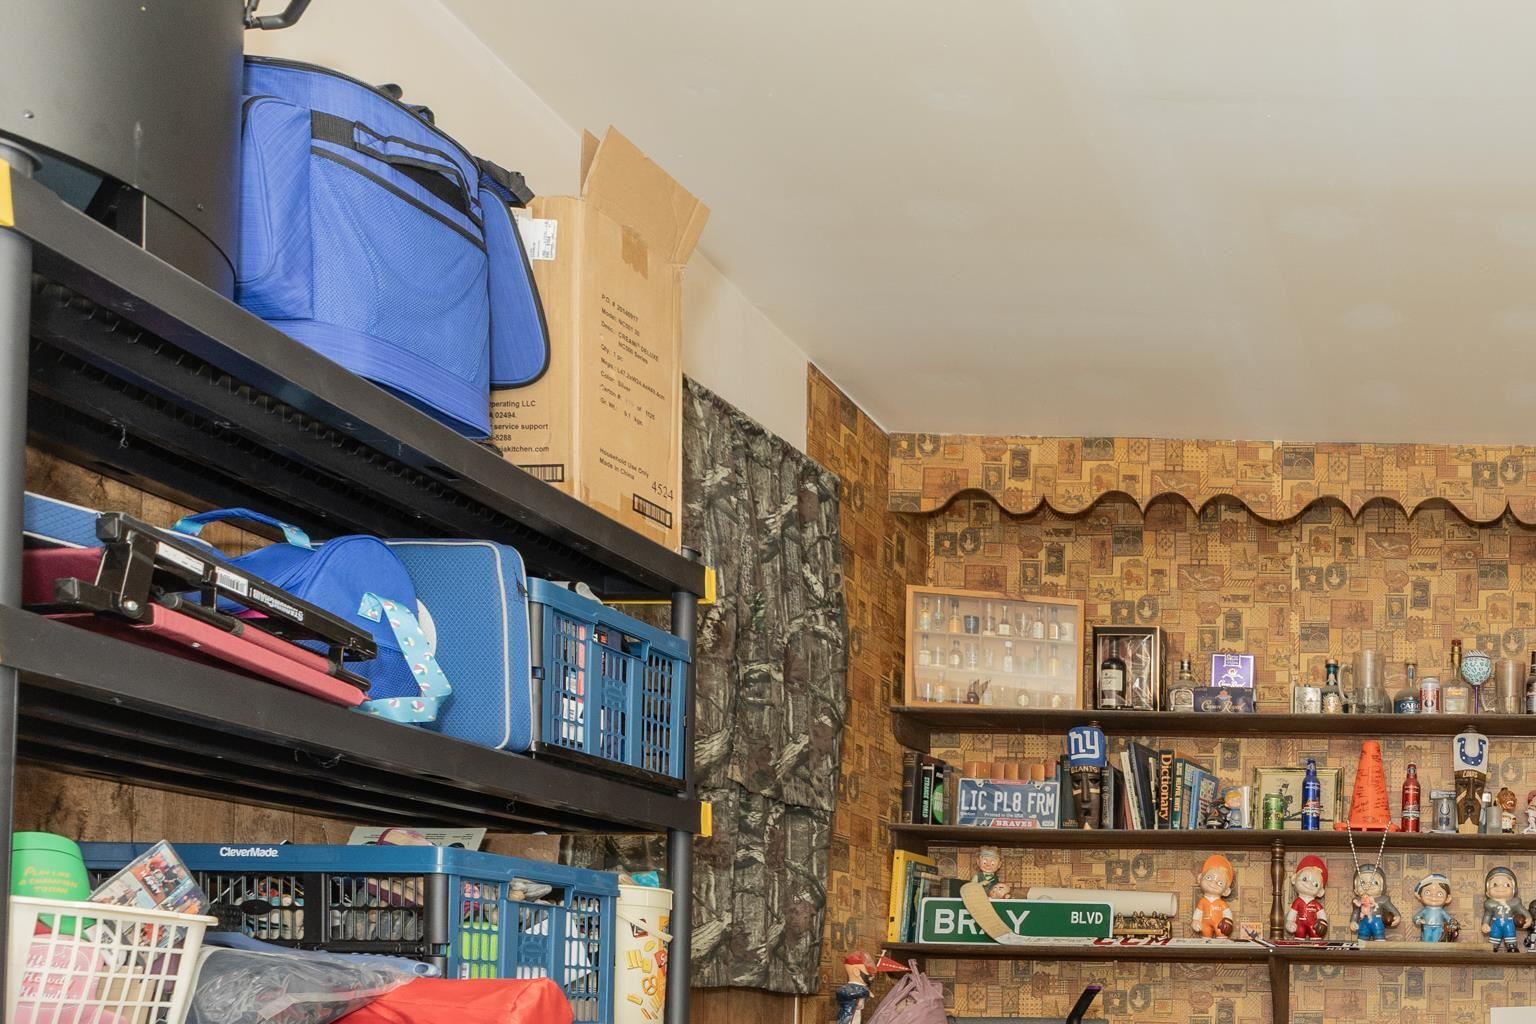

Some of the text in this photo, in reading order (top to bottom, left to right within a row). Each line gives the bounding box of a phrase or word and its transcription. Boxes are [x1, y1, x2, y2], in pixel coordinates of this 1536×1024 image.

[520, 422, 549, 431] support
[651, 481, 673, 501] 4524
[1158, 753, 1173, 821] Dictionary
[961, 790, 987, 811] LIC
[994, 791, 1021, 812] PL8
[1027, 791, 1055, 815] FRM
[219, 846, 279, 858] CleverMade
[934, 908, 1104, 936] BRY BLVD
